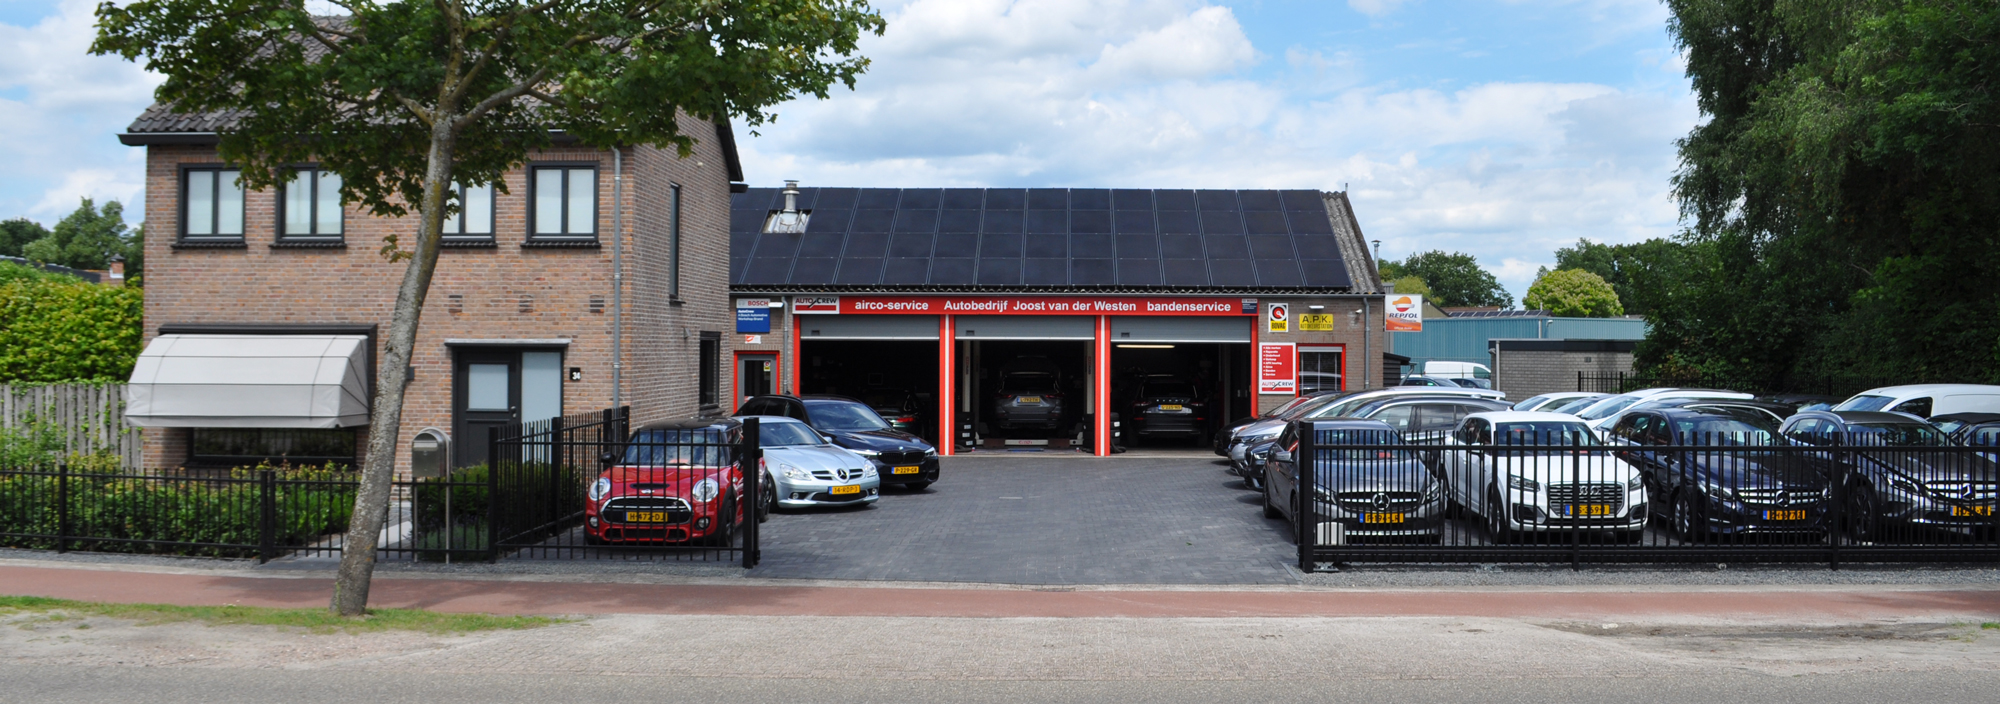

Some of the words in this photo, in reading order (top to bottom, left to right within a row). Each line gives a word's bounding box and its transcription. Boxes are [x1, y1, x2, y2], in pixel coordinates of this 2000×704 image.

[855, 300, 929, 310] airco-service
[944, 300, 1008, 312] Autobedrijf
[1013, 300, 1046, 310] Joost
[1072, 301, 1092, 310] der
[1094, 301, 1136, 311] Westen
[1147, 301, 1231, 312] bandenservice
[572, 372, 581, 380] 34
